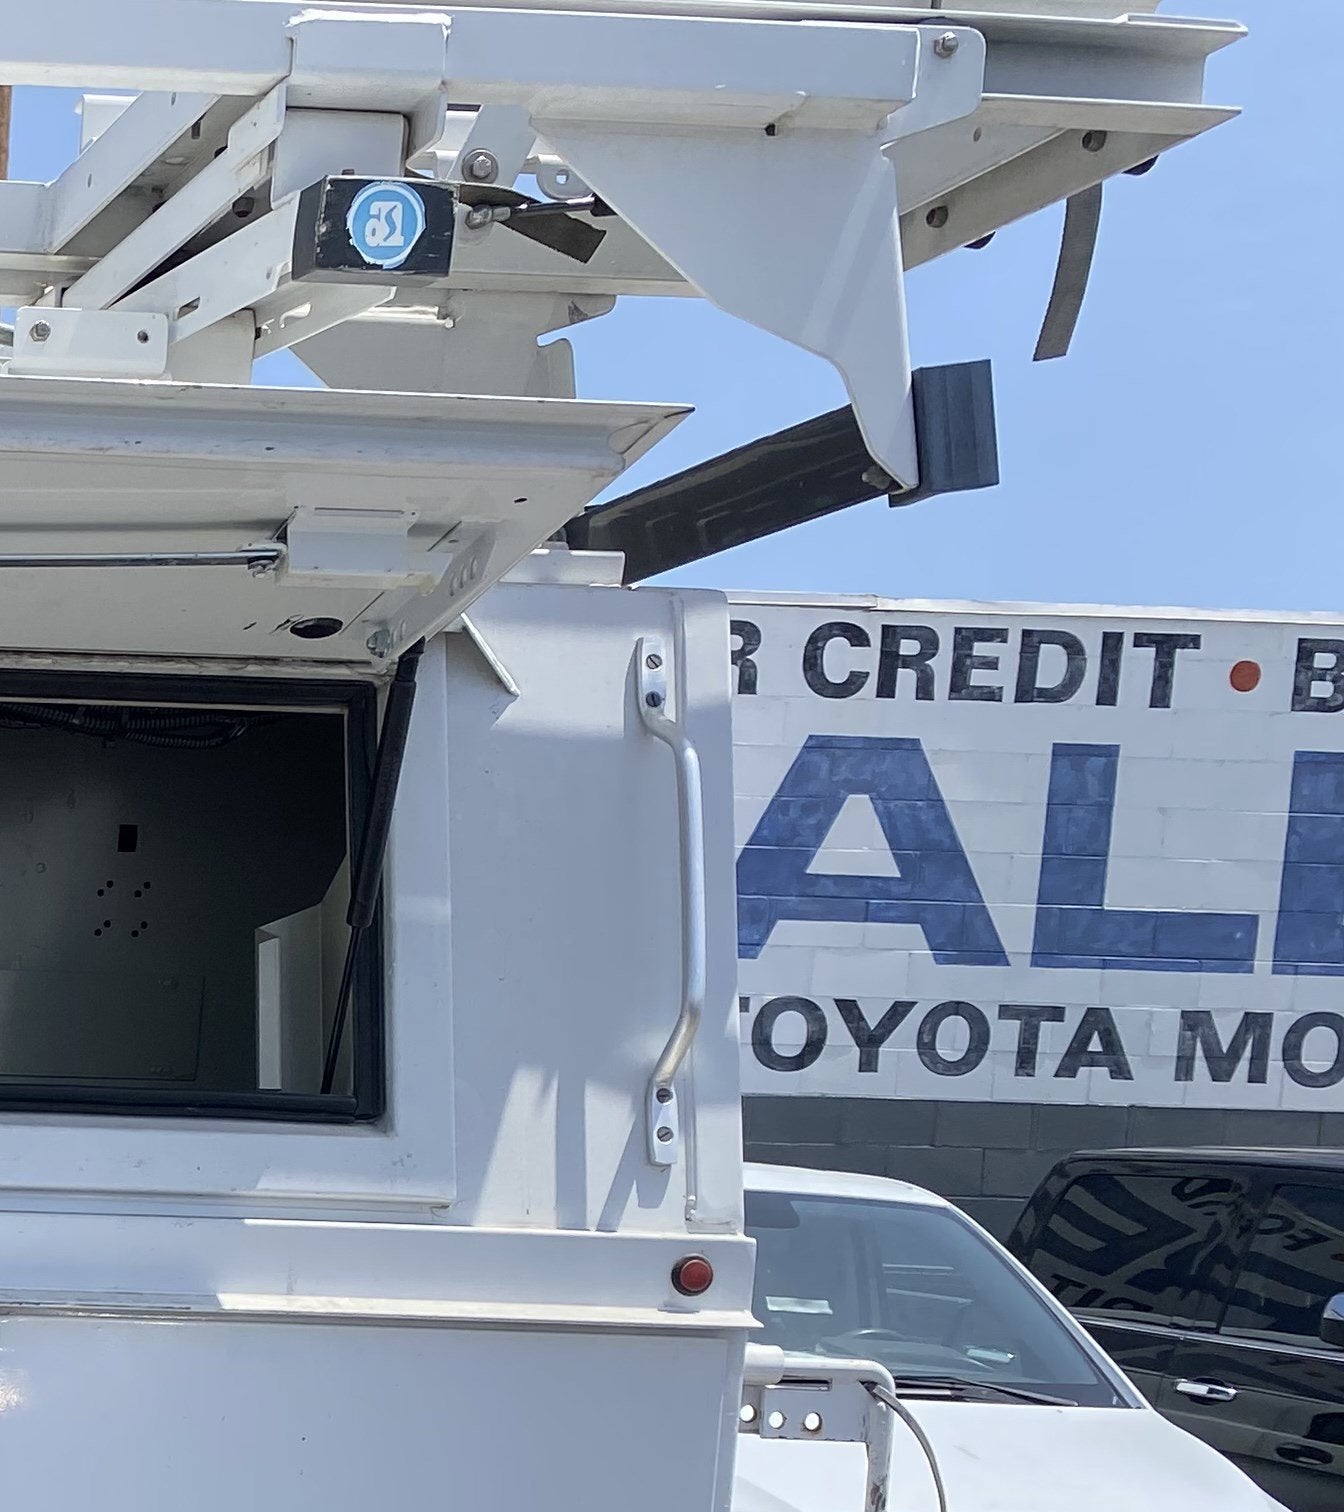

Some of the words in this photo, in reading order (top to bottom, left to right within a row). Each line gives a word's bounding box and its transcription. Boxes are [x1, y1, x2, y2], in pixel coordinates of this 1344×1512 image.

[802, 621, 1201, 709] CREDIT
[1290, 637, 1344, 713] B
[739, 995, 1133, 1081] OYOTA
